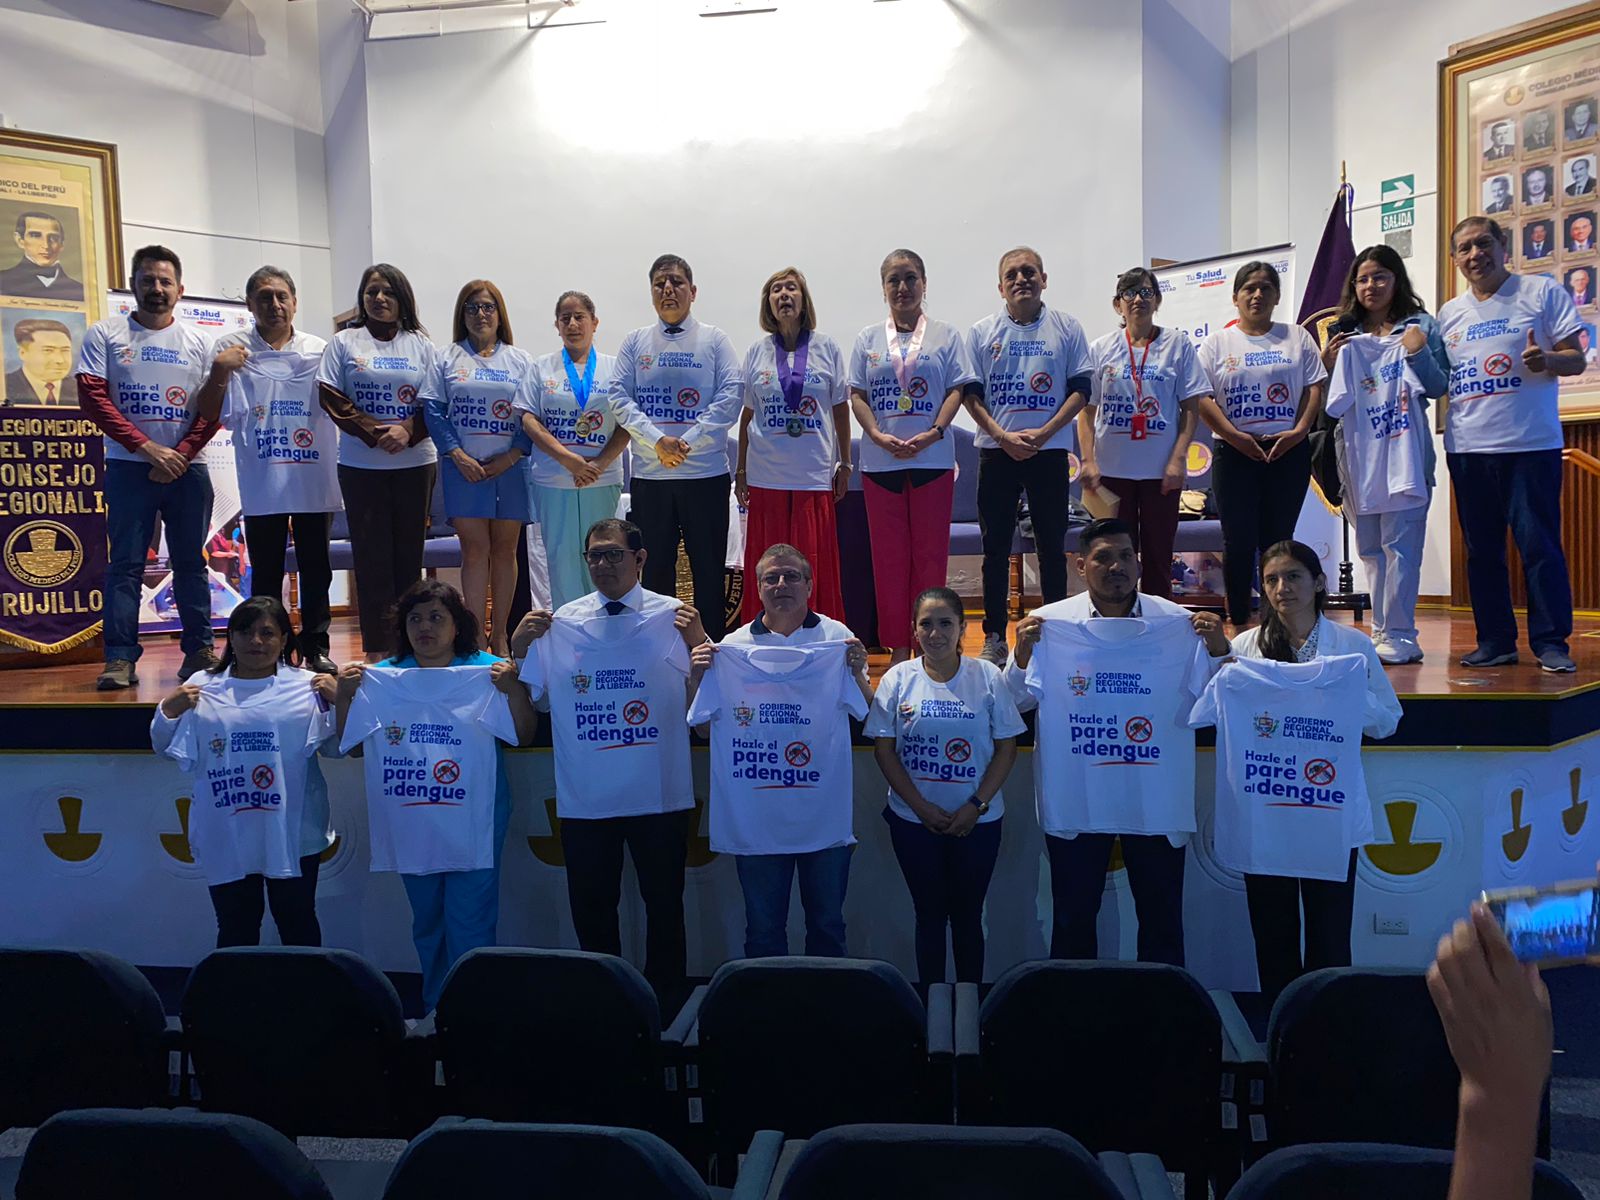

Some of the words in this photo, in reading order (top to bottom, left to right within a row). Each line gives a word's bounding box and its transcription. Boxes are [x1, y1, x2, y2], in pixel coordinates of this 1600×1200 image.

[21, 182, 39, 190] DEL
[1383, 212, 1412, 230] SALIDA
[1196, 268, 1222, 279] Salud
[193, 309, 220, 317] Salud
[1195, 323, 1208, 337] el
[1479, 328, 1520, 339] LIBERTAD
[1257, 358, 1292, 366] LIBERTAD
[1468, 356, 1477, 365] el
[1451, 367, 1477, 384] pare
[118, 382, 146, 390] Hazle
[636, 385, 660, 393] Hazle
[991, 382, 1025, 396] pare
[1455, 376, 1522, 394] dengue
[120, 391, 160, 404] pare
[356, 391, 392, 402] pare
[872, 386, 901, 400] pare
[477, 397, 486, 405] el
[638, 395, 672, 406] pare
[998, 393, 1056, 409] dengue
[1227, 393, 1261, 409] pare
[130, 402, 190, 420] dengue
[365, 402, 416, 420] dengu
[453, 405, 486, 416] pare
[569, 409, 577, 417] el
[764, 405, 791, 416] pare
[1103, 403, 1134, 415] pare
[1234, 406, 1294, 420] dengue
[0, 419, 42, 436] EGIO
[44, 419, 103, 437] MEDICO
[461, 416, 515, 433] dengue
[545, 417, 576, 427] pare
[768, 415, 821, 429] deue
[279, 427, 287, 435] el
[257, 436, 288, 450] pare
[33, 441, 86, 458] PERU
[258, 451, 266, 459] al
[267, 446, 319, 462] dengue
[0, 463, 95, 487] ONSEJO
[29, 575, 61, 584] MEDICO
[0, 589, 103, 616] RUJILLO
[1096, 672, 1141, 680] GOBIERNO
[607, 682, 645, 690] LIBERTAD
[1109, 687, 1151, 695] LIBERTAD
[575, 702, 603, 711] Hazle
[606, 701, 615, 710] el
[759, 703, 801, 711] GOBIERNO
[577, 713, 617, 729] pare
[772, 717, 811, 725] LIBERTAD
[1069, 714, 1103, 724] Hazle
[1107, 715, 1117, 725] el
[1284, 716, 1334, 727] GOBIERNO
[411, 723, 453, 732] GOBIERNO
[1284, 723, 1331, 735] REGIONAL
[410, 730, 451, 738] REGIONAL
[578, 732, 586, 740] al
[588, 726, 659, 744] dengue
[929, 735, 939, 744] el
[1071, 726, 1118, 742] pare
[1297, 731, 1344, 743] LIBERTAD
[732, 738, 764, 749] Hazle
[768, 740, 777, 750] el
[903, 745, 939, 757] pare
[1072, 744, 1081, 754] al
[1083, 740, 1160, 762] dengue
[383, 756, 413, 766] Hazle
[417, 757, 427, 767] el
[733, 751, 778, 766] pare
[1245, 750, 1280, 763] Hazle
[1284, 755, 1296, 765] el
[234, 765, 244, 774] el
[911, 757, 976, 780] dengue
[1246, 764, 1296, 780] pare
[384, 768, 426, 783] pare
[733, 769, 742, 778] al
[745, 764, 820, 786] dengue
[211, 777, 245, 797] pare
[394, 781, 466, 802] dengue
[1244, 783, 1255, 793] al
[1257, 778, 1345, 805] dengue
[223, 791, 281, 807] dengue
